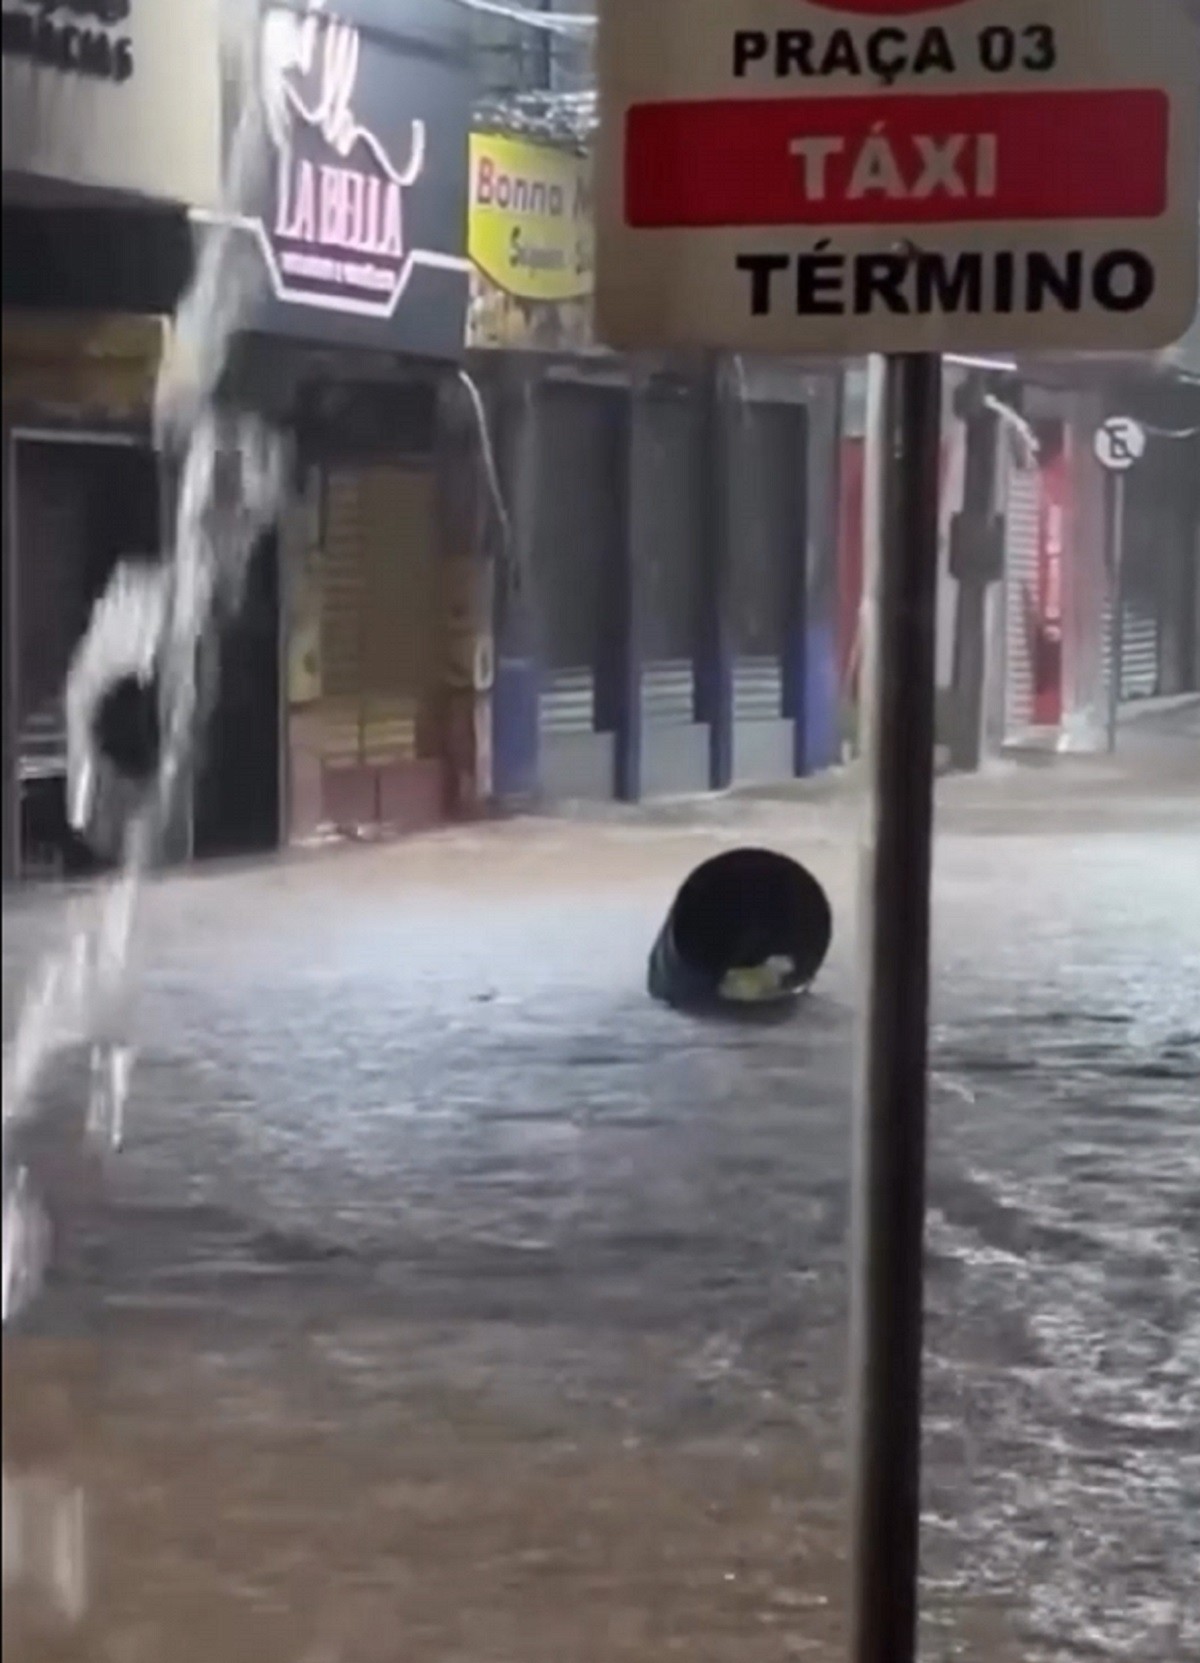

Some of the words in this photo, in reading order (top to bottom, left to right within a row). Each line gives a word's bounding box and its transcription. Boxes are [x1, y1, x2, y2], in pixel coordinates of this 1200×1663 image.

[732, 26, 956, 86] PRAÇA
[977, 24, 1057, 73] 03
[477, 156, 563, 216] Bonna
[788, 121, 998, 200] TÁXI
[735, 238, 1155, 316] TÉRMINO
